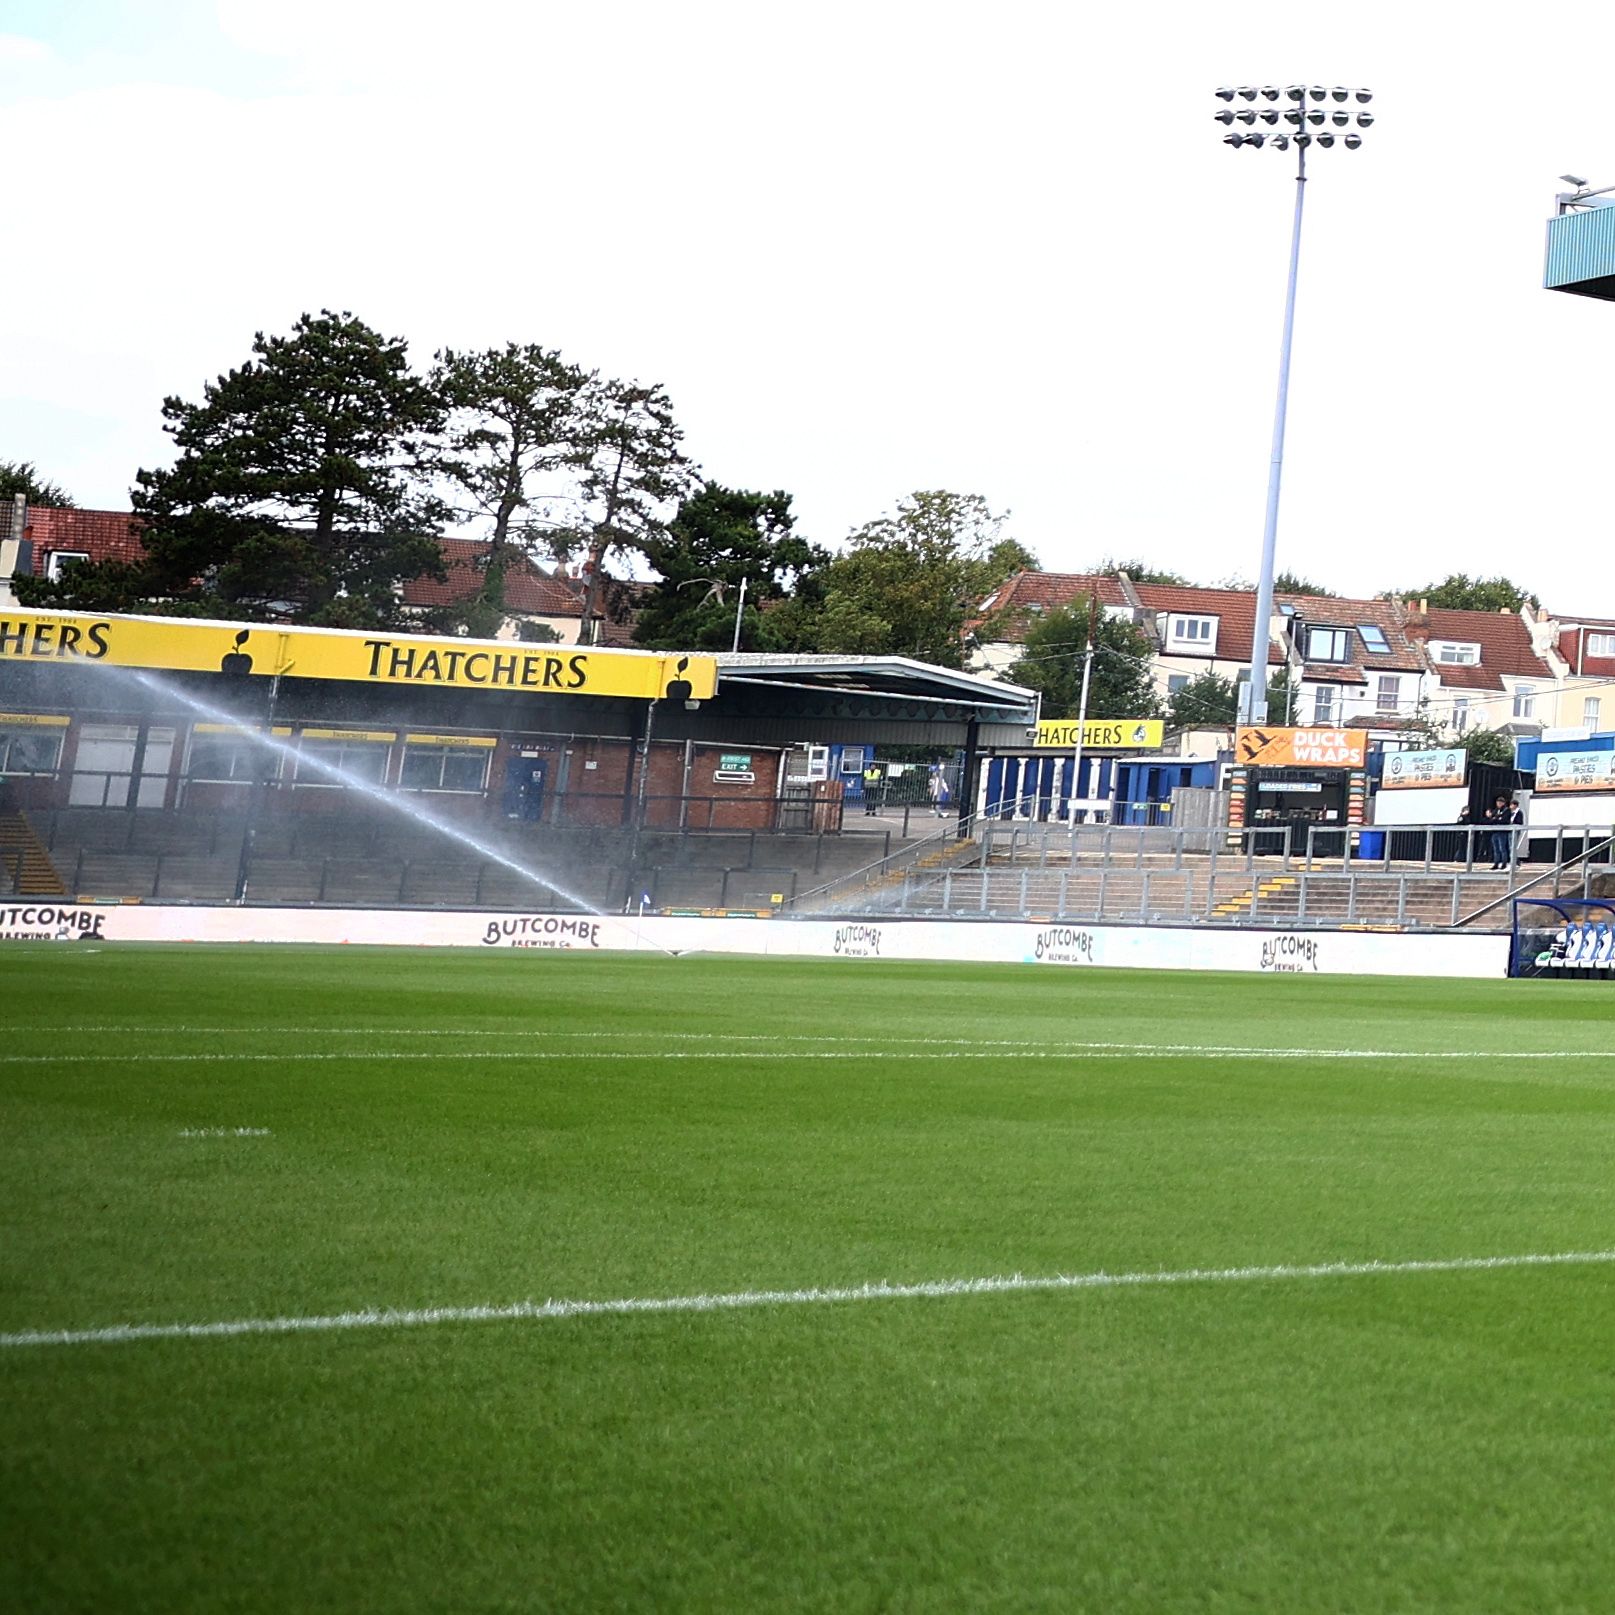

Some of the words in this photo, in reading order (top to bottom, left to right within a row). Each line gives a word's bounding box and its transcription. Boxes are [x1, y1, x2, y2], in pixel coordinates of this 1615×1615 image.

[363, 640, 588, 689] THATCHERS
[1038, 724, 1123, 745] HATCHERS
[1293, 731, 1346, 747] DUCK
[1293, 747, 1361, 763] WRAPS
[482, 918, 601, 947] BUTCOMBE
[833, 925, 882, 955] BUTCOMBE
[1035, 928, 1093, 963] BUTCOMBE
